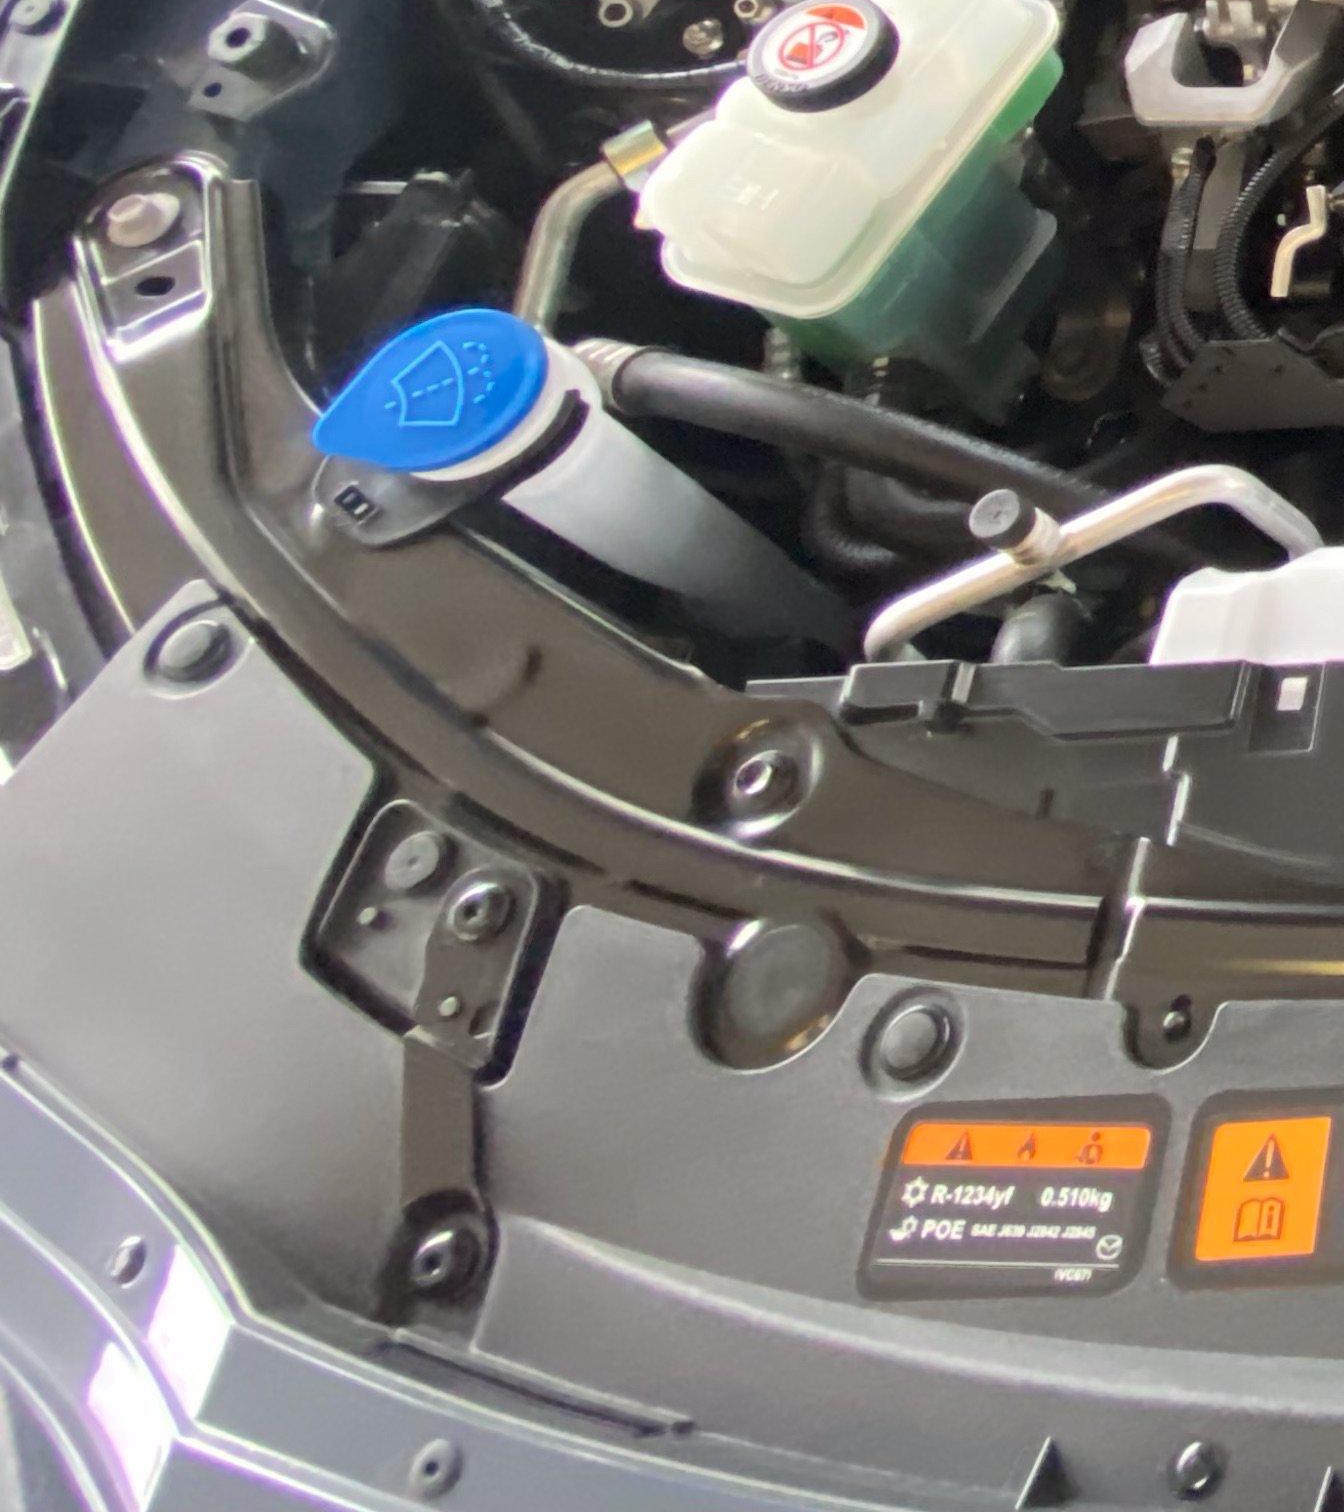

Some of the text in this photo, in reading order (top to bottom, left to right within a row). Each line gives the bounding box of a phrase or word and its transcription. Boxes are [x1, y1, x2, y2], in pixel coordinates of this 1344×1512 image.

[930, 1184, 1113, 1212] R-1234yf 0.510kg
[921, 1219, 966, 1239] POE
[970, 1223, 997, 1237] SAE
